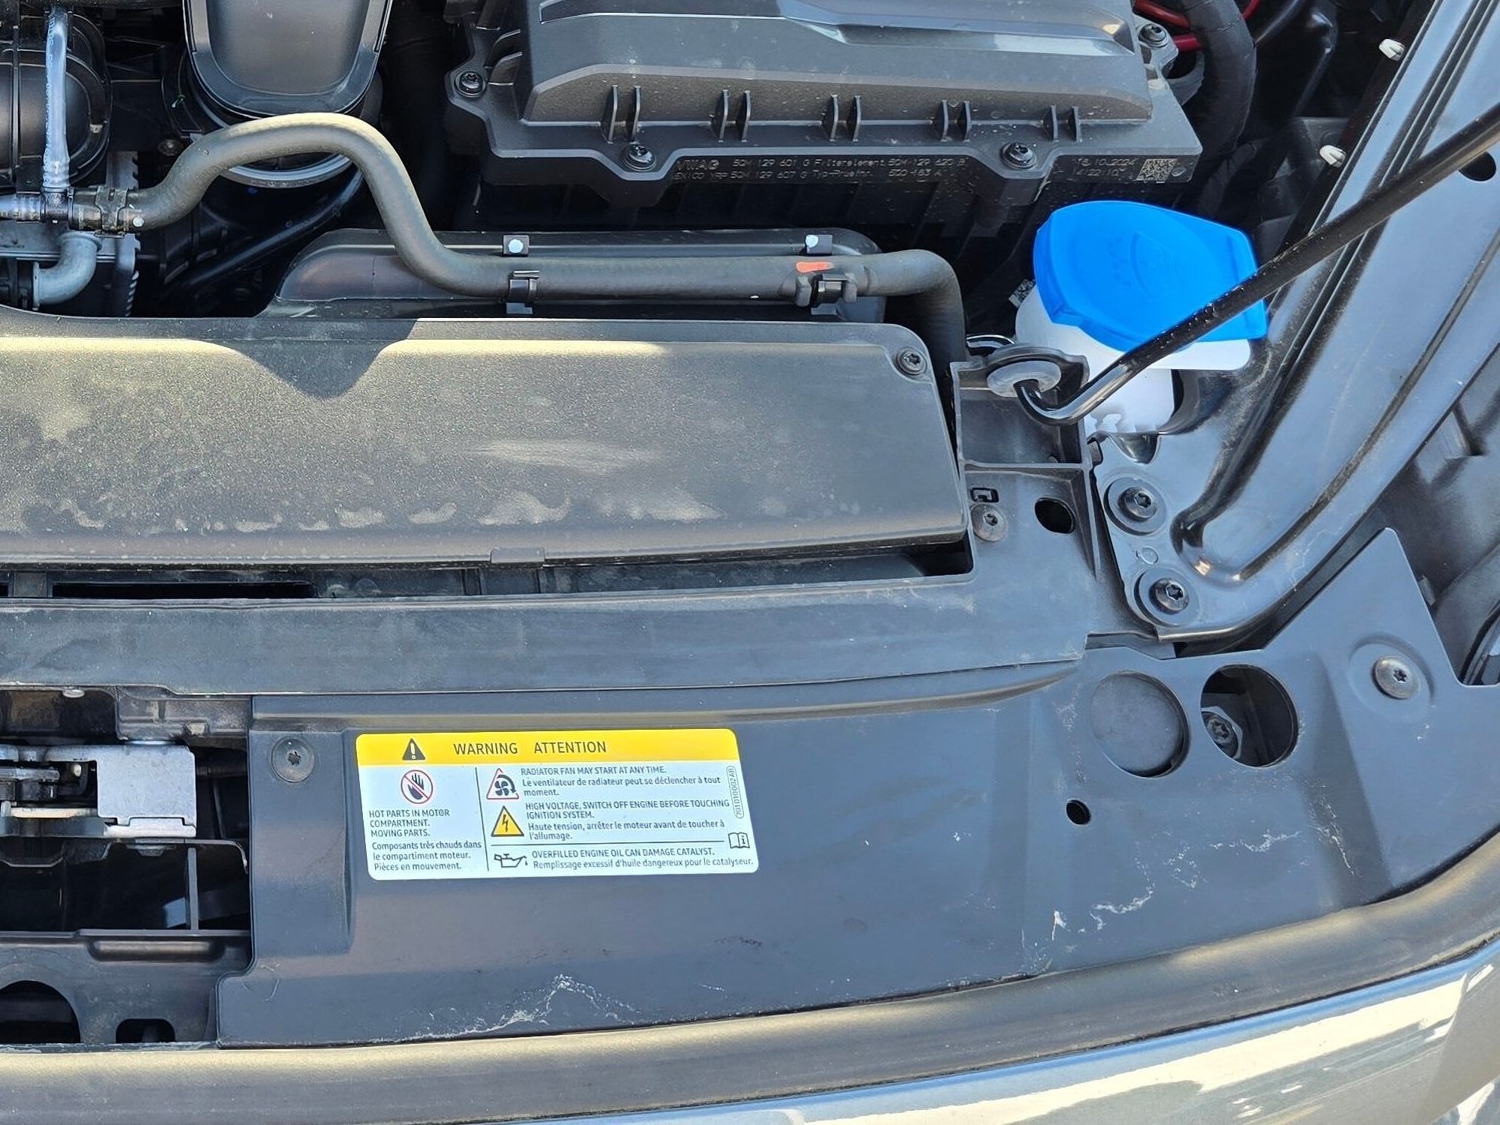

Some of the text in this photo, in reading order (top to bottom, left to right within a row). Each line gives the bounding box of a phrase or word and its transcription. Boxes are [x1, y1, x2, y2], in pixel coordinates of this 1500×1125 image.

[453, 741, 606, 755] WARNING ATTENTION
[521, 766, 667, 776] RADIATOR FAN MAY START AT ANY TIME.
[522, 778, 532, 787] Le
[533, 778, 575, 786] ventilateur
[576, 777, 587, 786] de
[588, 776, 623, 786] radiateur
[626, 778, 643, 787] peut
[654, 776, 696, 785] déclencher
[698, 775, 703, 784] à
[704, 776, 721, 784] tout
[525, 802, 545, 810] HIGH
[583, 801, 612, 809] SWITCH
[613, 801, 629, 809] OFF
[630, 800, 657, 808] ENGINE
[659, 800, 690, 808] BEFORE
[691, 799, 730, 807] TOUCHING
[368, 808, 450, 818] HOT PARTS IN MOTOR
[526, 811, 595, 820] IGNITION SYSTEM.
[369, 819, 431, 828] COMPARTMENT.
[528, 822, 552, 831] Haute
[614, 821, 622, 829] le
[623, 821, 652, 829] moteur
[677, 820, 687, 828] de
[688, 819, 718, 828] toucher
[719, 819, 725, 827] à
[370, 828, 431, 837] MOVING PARTS.
[372, 839, 482, 851] Composants très chauds dans
[373, 851, 472, 862] le compartiment moteur.
[532, 847, 715, 858] OVERFILLED ENGINE OIL CAN DAMAGE CATALYST.
[374, 862, 462, 871] Pièces en mouvement.
[533, 859, 582, 870] Remplissage
[583, 859, 613, 868] excessif
[642, 859, 683, 869] dangereux
[684, 860, 703, 868] pour
[704, 858, 710, 866] le
[712, 858, 754, 867] catalyseur.
